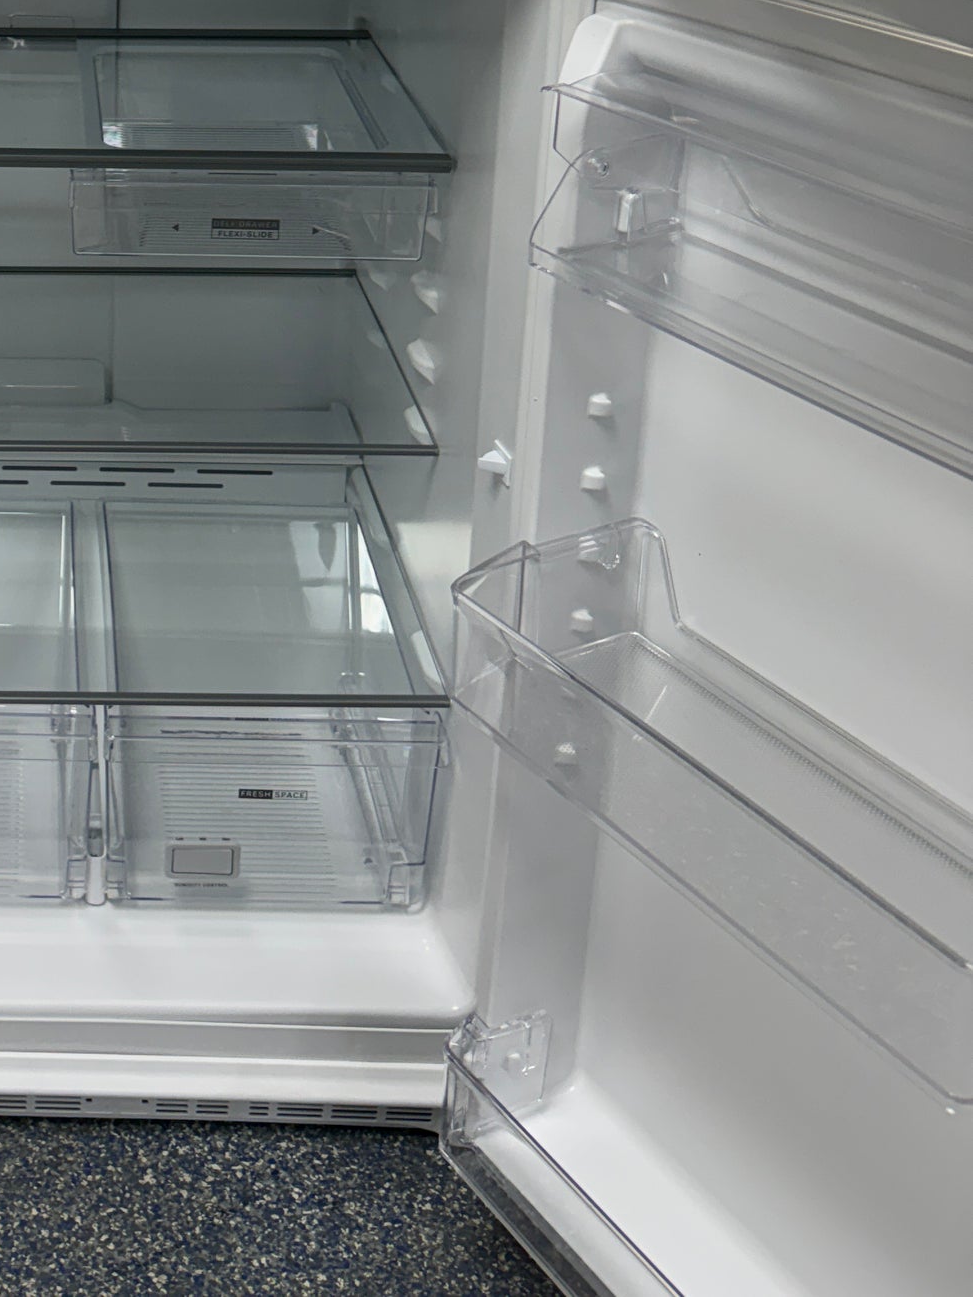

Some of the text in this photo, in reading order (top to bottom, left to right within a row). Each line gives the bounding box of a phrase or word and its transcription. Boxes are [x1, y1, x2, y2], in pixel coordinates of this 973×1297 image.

[218, 230, 274, 239] FLEXI-SLIDE
[240, 790, 305, 799] FRESH SPACE
